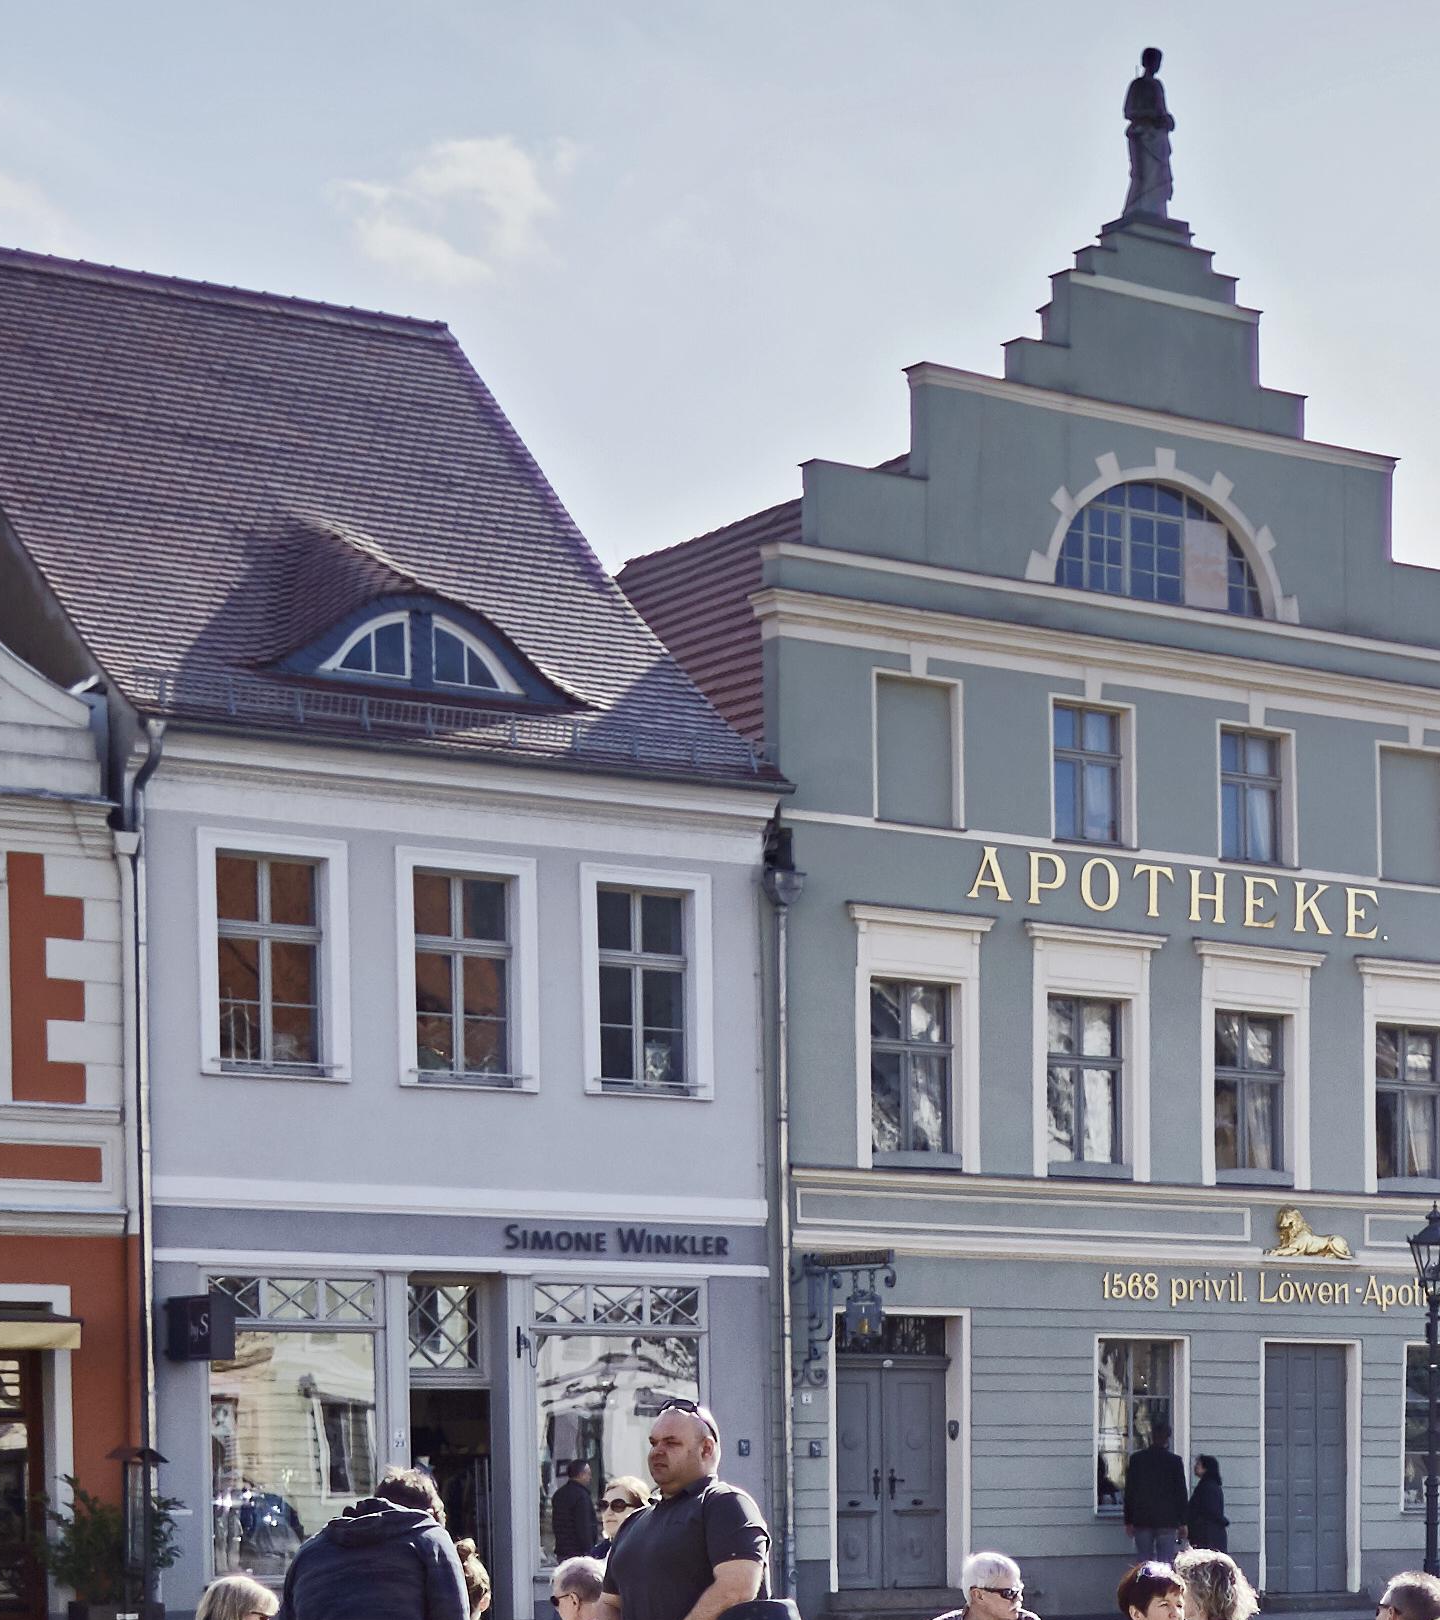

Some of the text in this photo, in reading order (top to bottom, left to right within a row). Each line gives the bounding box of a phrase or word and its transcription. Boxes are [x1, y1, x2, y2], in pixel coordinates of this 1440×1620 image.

[504, 1224, 729, 1256] SIMONE WINKLER
[1102, 1272, 1159, 1300] 1568
[1170, 1271, 1248, 1307] privil.
